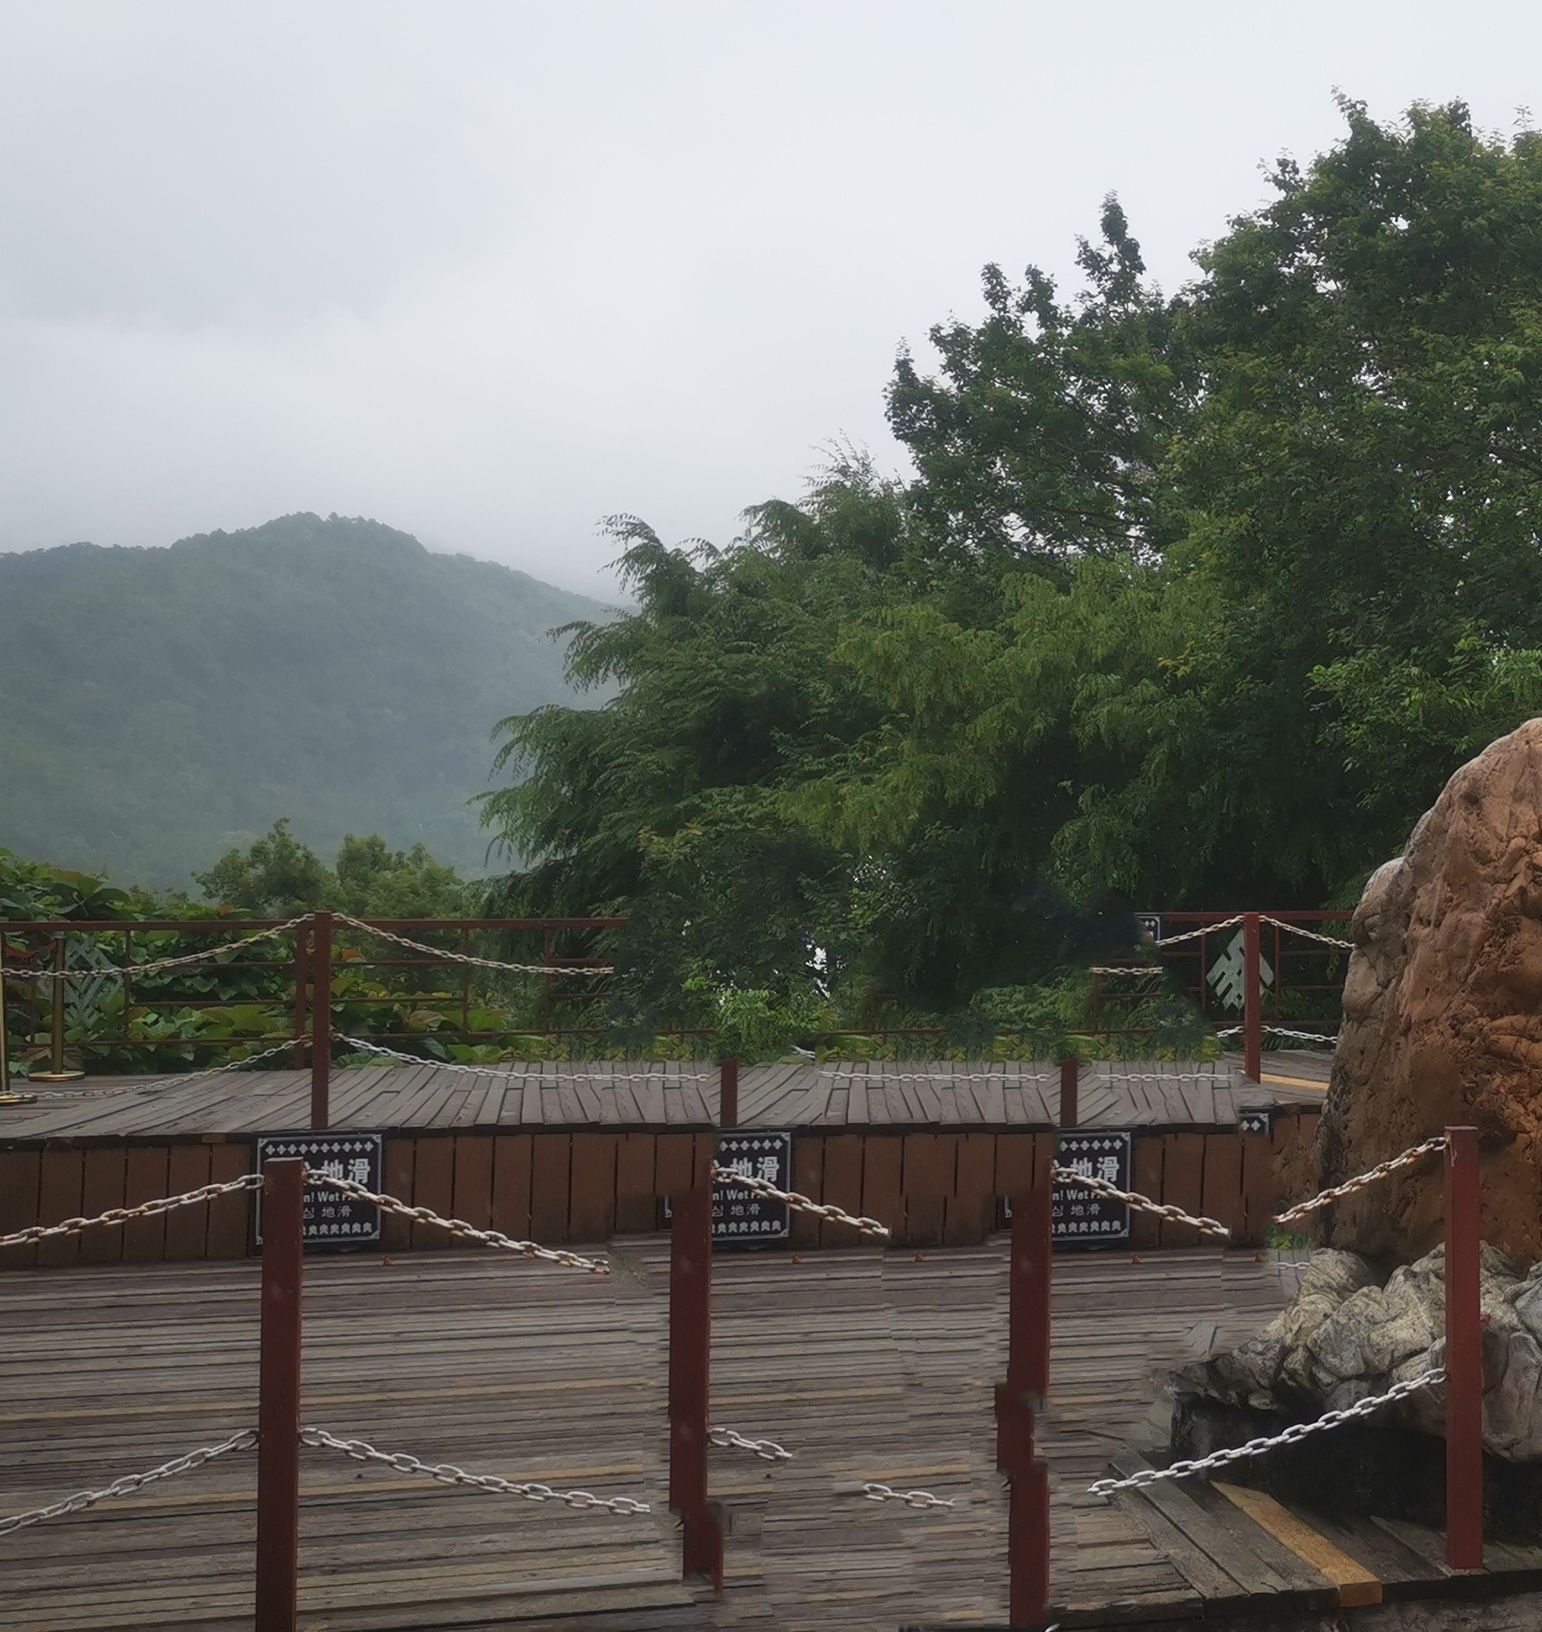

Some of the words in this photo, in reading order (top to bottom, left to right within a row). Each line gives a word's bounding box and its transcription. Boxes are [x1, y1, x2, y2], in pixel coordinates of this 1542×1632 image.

[317, 1191, 340, 1202] Wet
[726, 1189, 749, 1200] Wet
[1066, 1189, 1089, 1200] Wet
